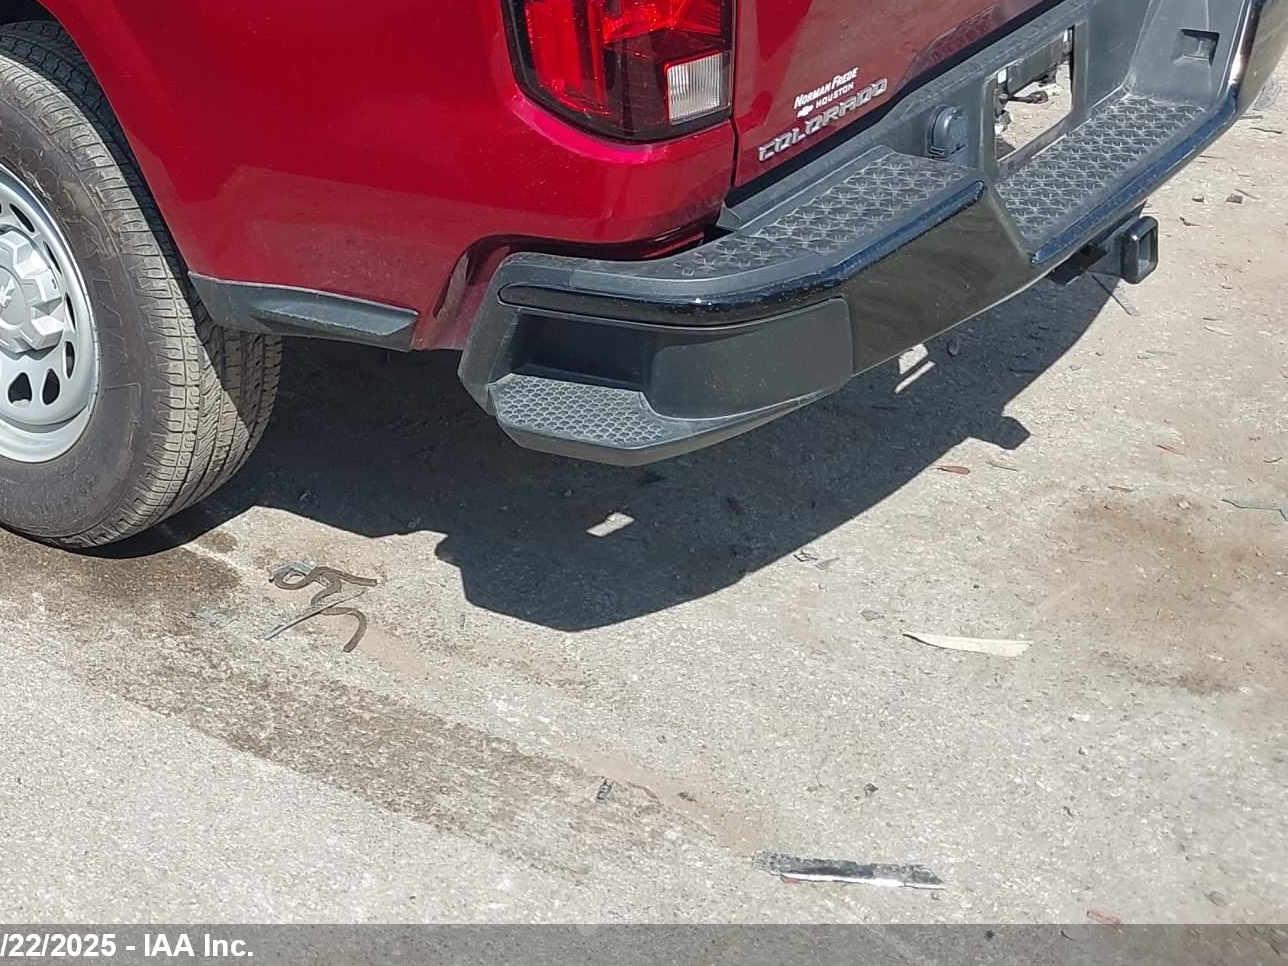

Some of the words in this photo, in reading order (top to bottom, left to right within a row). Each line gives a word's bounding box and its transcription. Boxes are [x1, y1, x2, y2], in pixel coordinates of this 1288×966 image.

[793, 81, 832, 110] NORMAN
[831, 66, 859, 90] FREDE
[815, 81, 855, 109] HOUSTON
[757, 77, 888, 162] COLORADO
